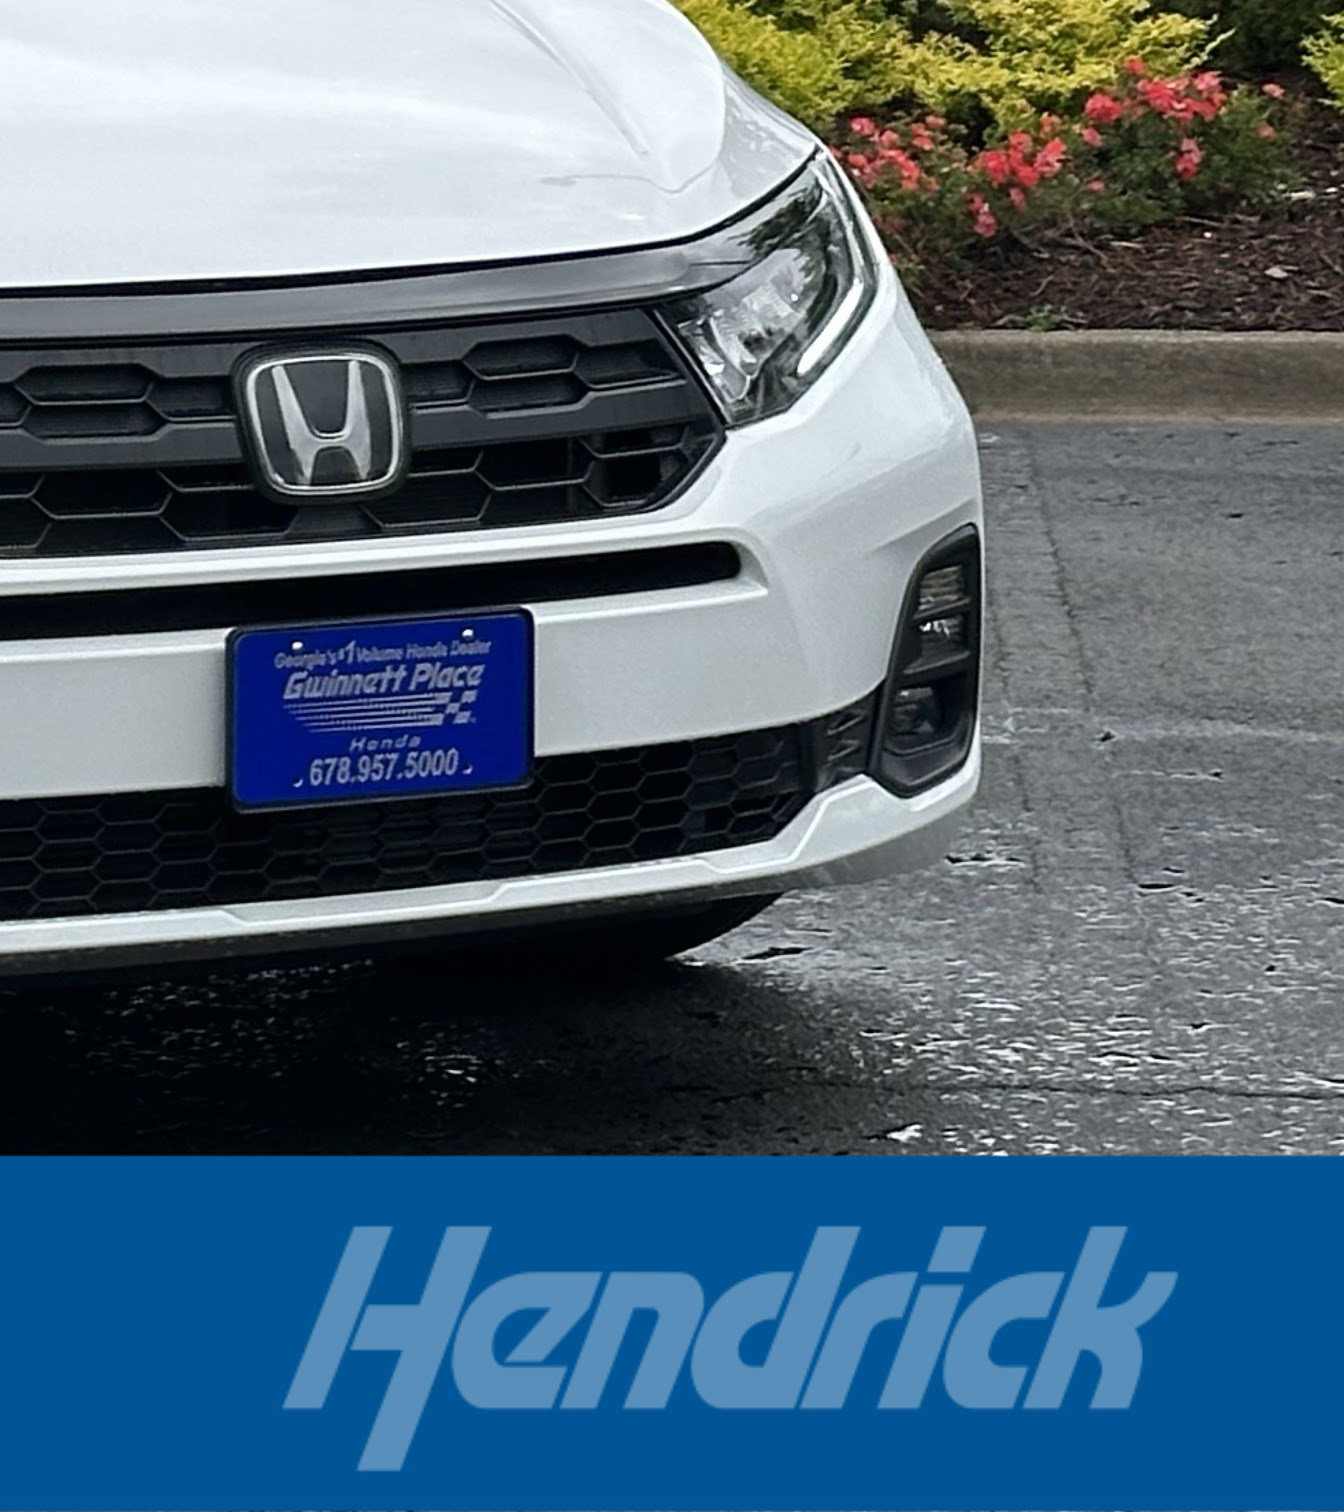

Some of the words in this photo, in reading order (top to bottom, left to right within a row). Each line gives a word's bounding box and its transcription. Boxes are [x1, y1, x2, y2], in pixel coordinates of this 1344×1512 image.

[275, 650, 338, 671] Georgia's
[356, 646, 404, 664] Volume
[406, 641, 448, 659] Honda
[450, 638, 492, 657] Dealer
[284, 665, 406, 699] Gwinnett
[408, 662, 486, 691] Place
[348, 734, 422, 752] Honda
[310, 749, 459, 786] 678.957.5000
